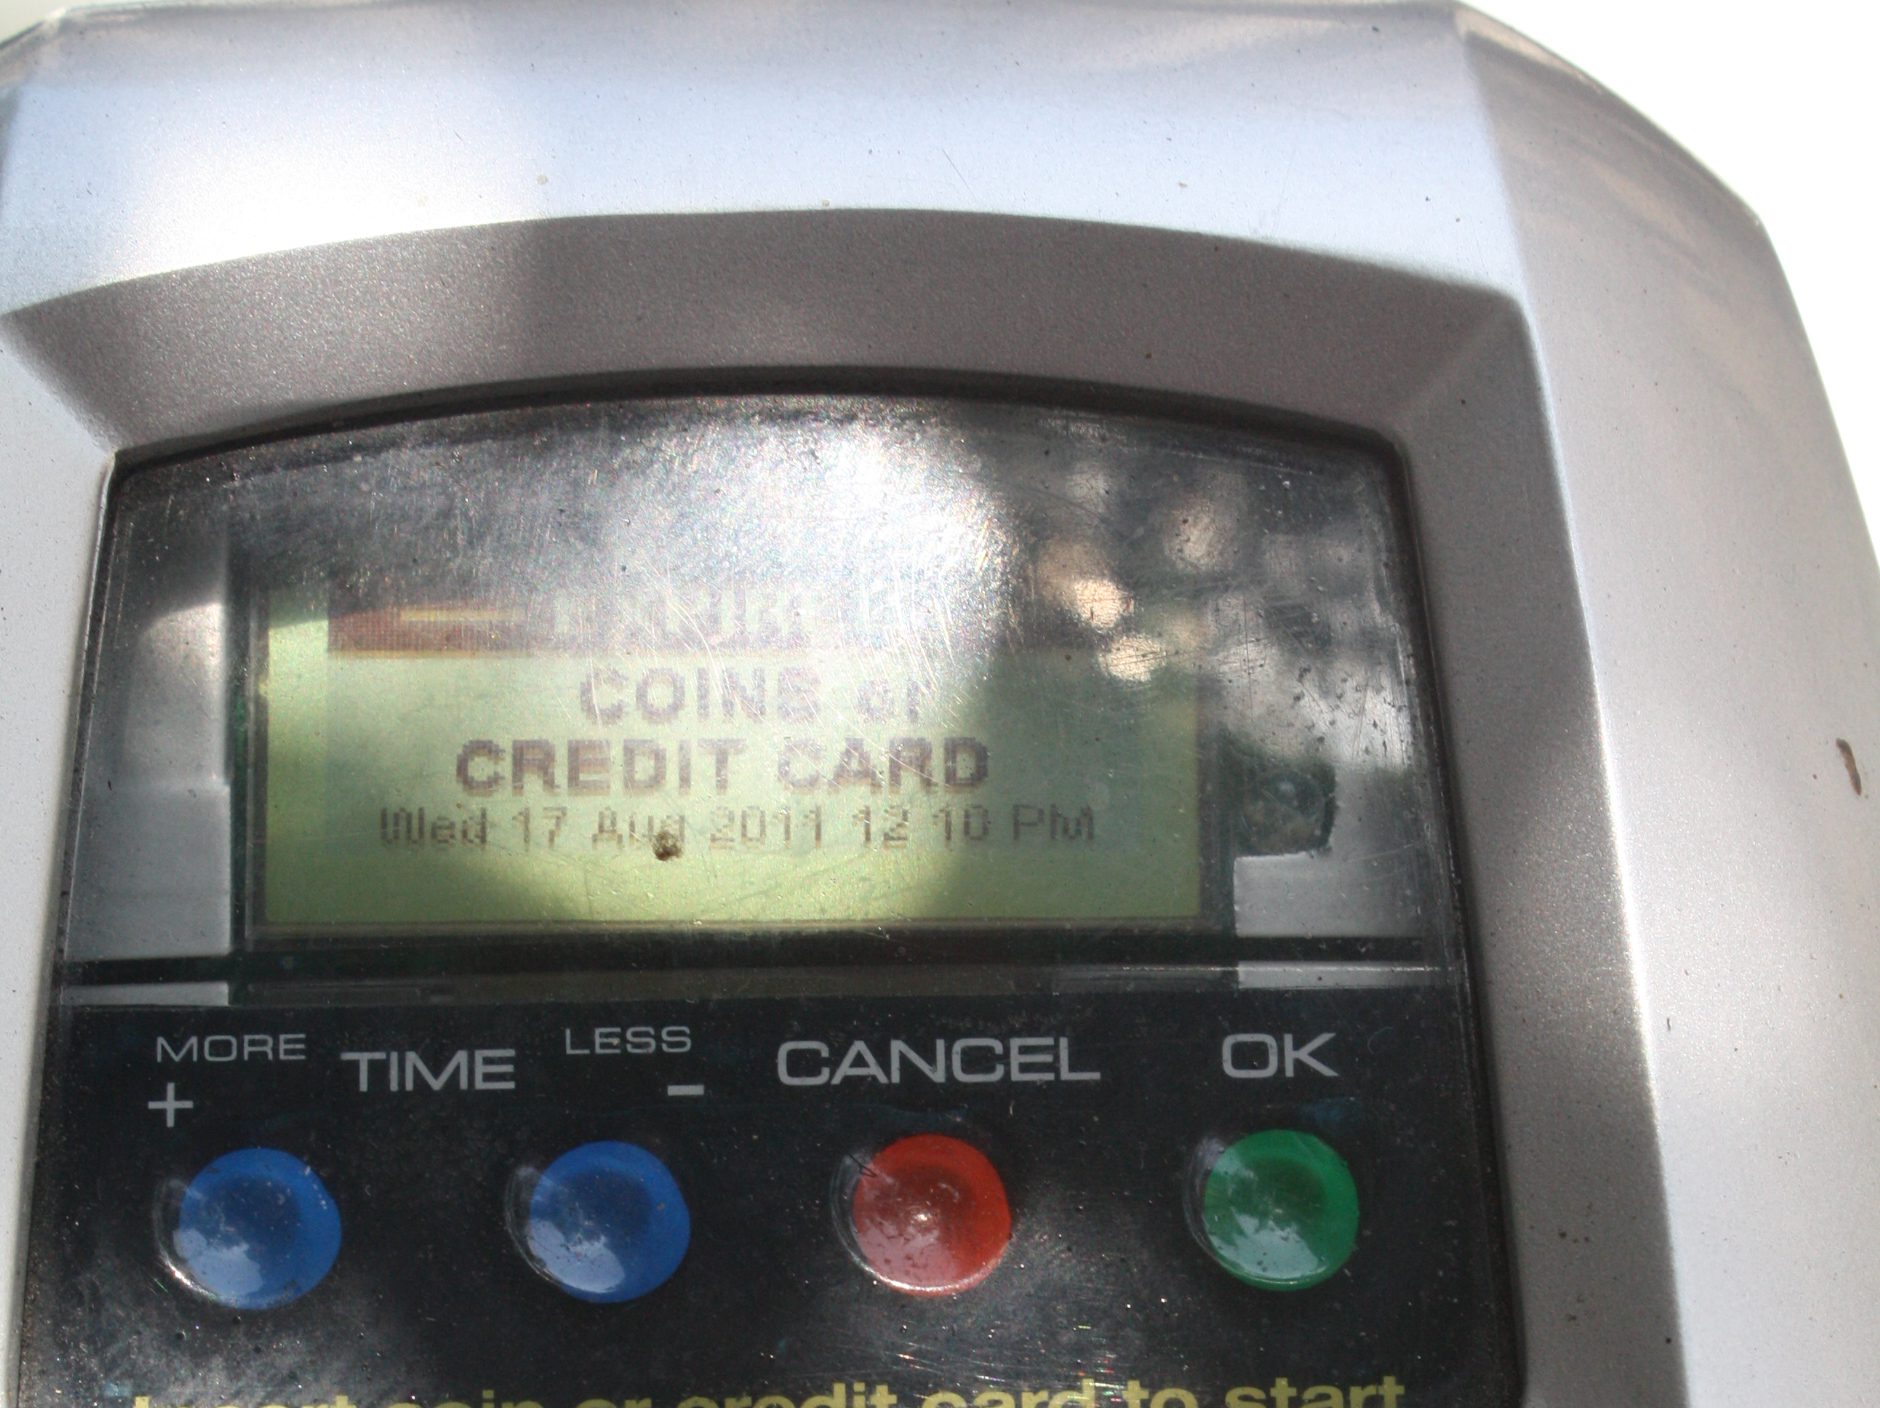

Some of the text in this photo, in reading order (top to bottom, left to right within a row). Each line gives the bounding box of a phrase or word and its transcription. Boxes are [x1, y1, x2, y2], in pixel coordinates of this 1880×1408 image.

[455, 736, 989, 796] CREDIT CARD
[380, 806, 488, 850] Wed
[512, 806, 568, 850] 17
[709, 804, 823, 848] 2011
[1012, 803, 1095, 844] PM
[156, 1034, 307, 1063] MORE
[565, 1026, 692, 1055] LESS
[777, 1037, 1101, 1086] CANCEL
[1221, 1033, 1339, 1079] OK
[341, 1049, 516, 1092] TIME
